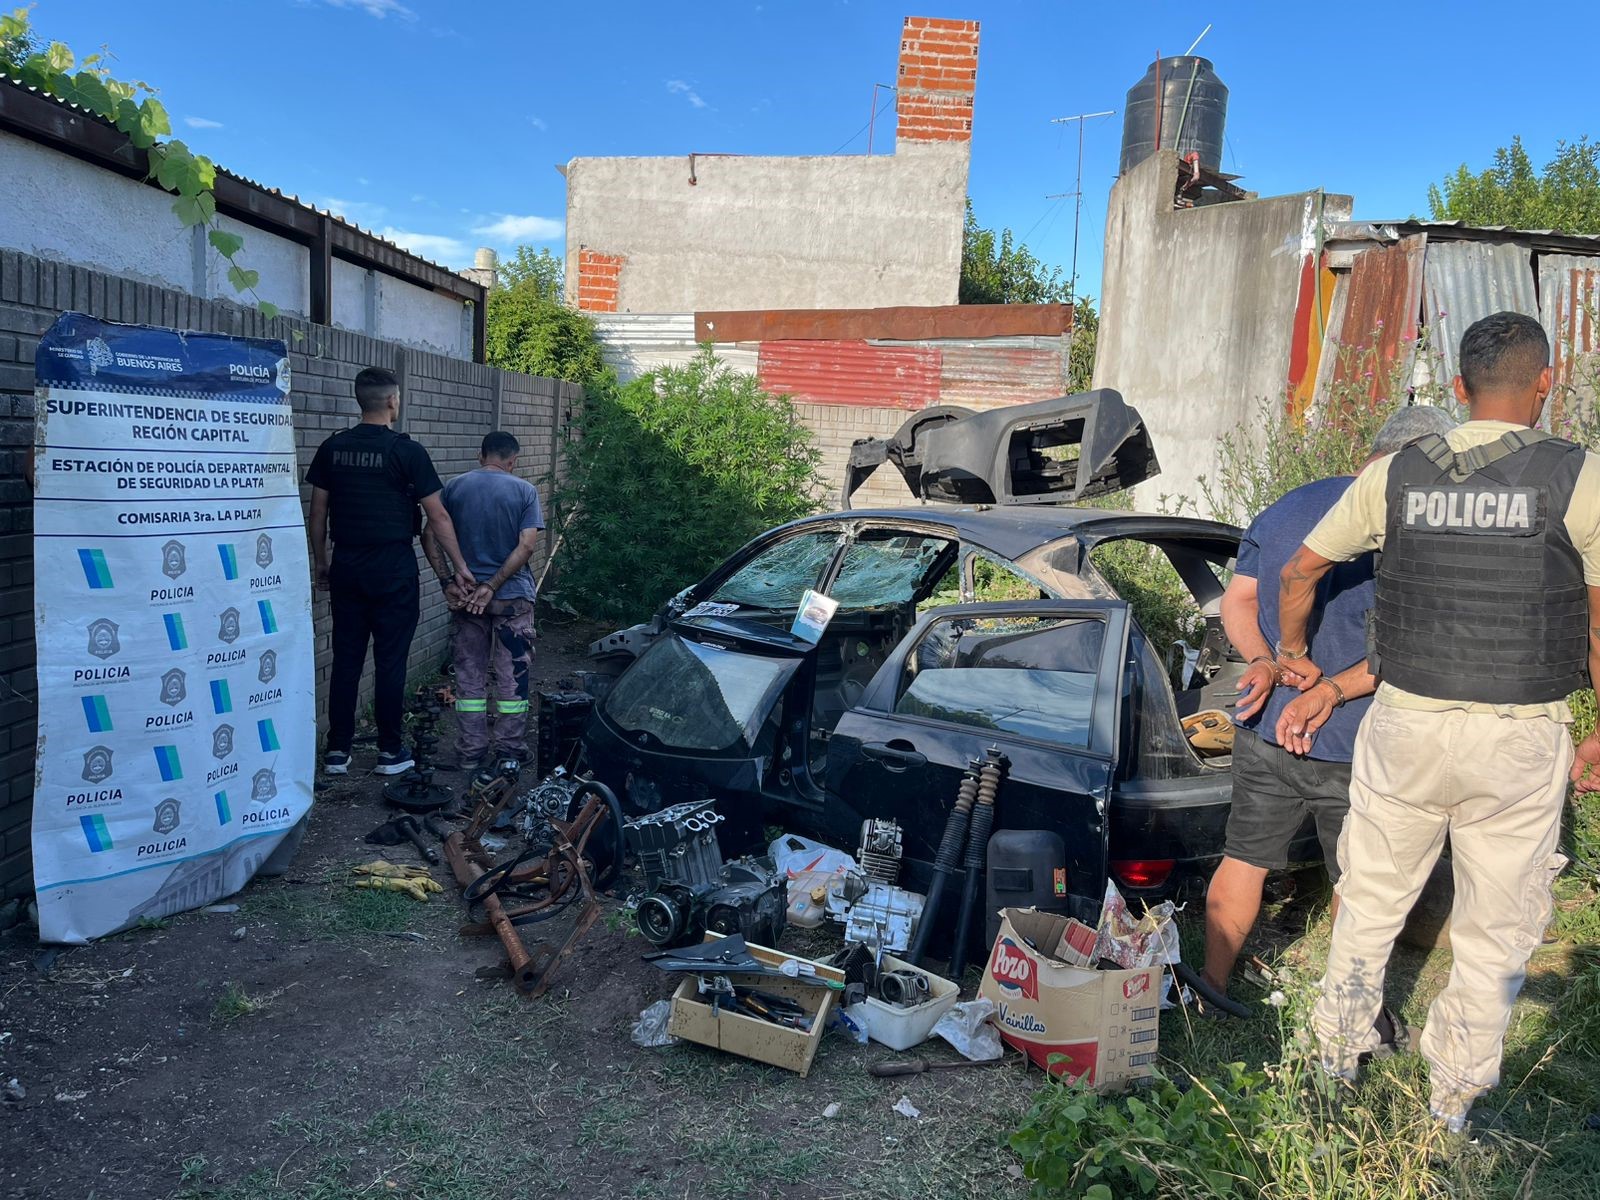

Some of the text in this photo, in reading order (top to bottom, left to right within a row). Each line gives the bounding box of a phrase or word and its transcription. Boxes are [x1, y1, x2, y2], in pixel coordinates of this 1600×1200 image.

[116, 357, 183, 372] BUENOS AIRES
[230, 363, 270, 378] POLICÍA
[46, 400, 207, 422] SUPERINTENDENCIA
[211, 410, 230, 423] DE
[132, 424, 249, 442] REGIÓN CAPITAL
[52, 458, 290, 474] ESTACIÓN DE POLICÍA DEPARTAMENTAL
[332, 451, 383, 468] POLICIA
[117, 477, 264, 489] DE SEGURIDAD LA PLATA
[117, 509, 262, 524] COMISARIA 3ra. LA PLATA
[1406, 491, 1529, 528] POLICIA
[250, 575, 281, 588] POLICIA
[151, 586, 194, 600] POLICIA
[207, 649, 246, 664] POLICIA
[74, 666, 130, 681] POLICIA
[249, 688, 282, 704] POLICIA
[146, 711, 193, 728] POLICIA
[207, 763, 238, 782] POLICIA
[67, 789, 122, 805] POLICIA
[242, 808, 290, 824] POLICIA
[137, 837, 187, 856] POLICIA
[999, 1001, 1046, 1033] Vainillas
